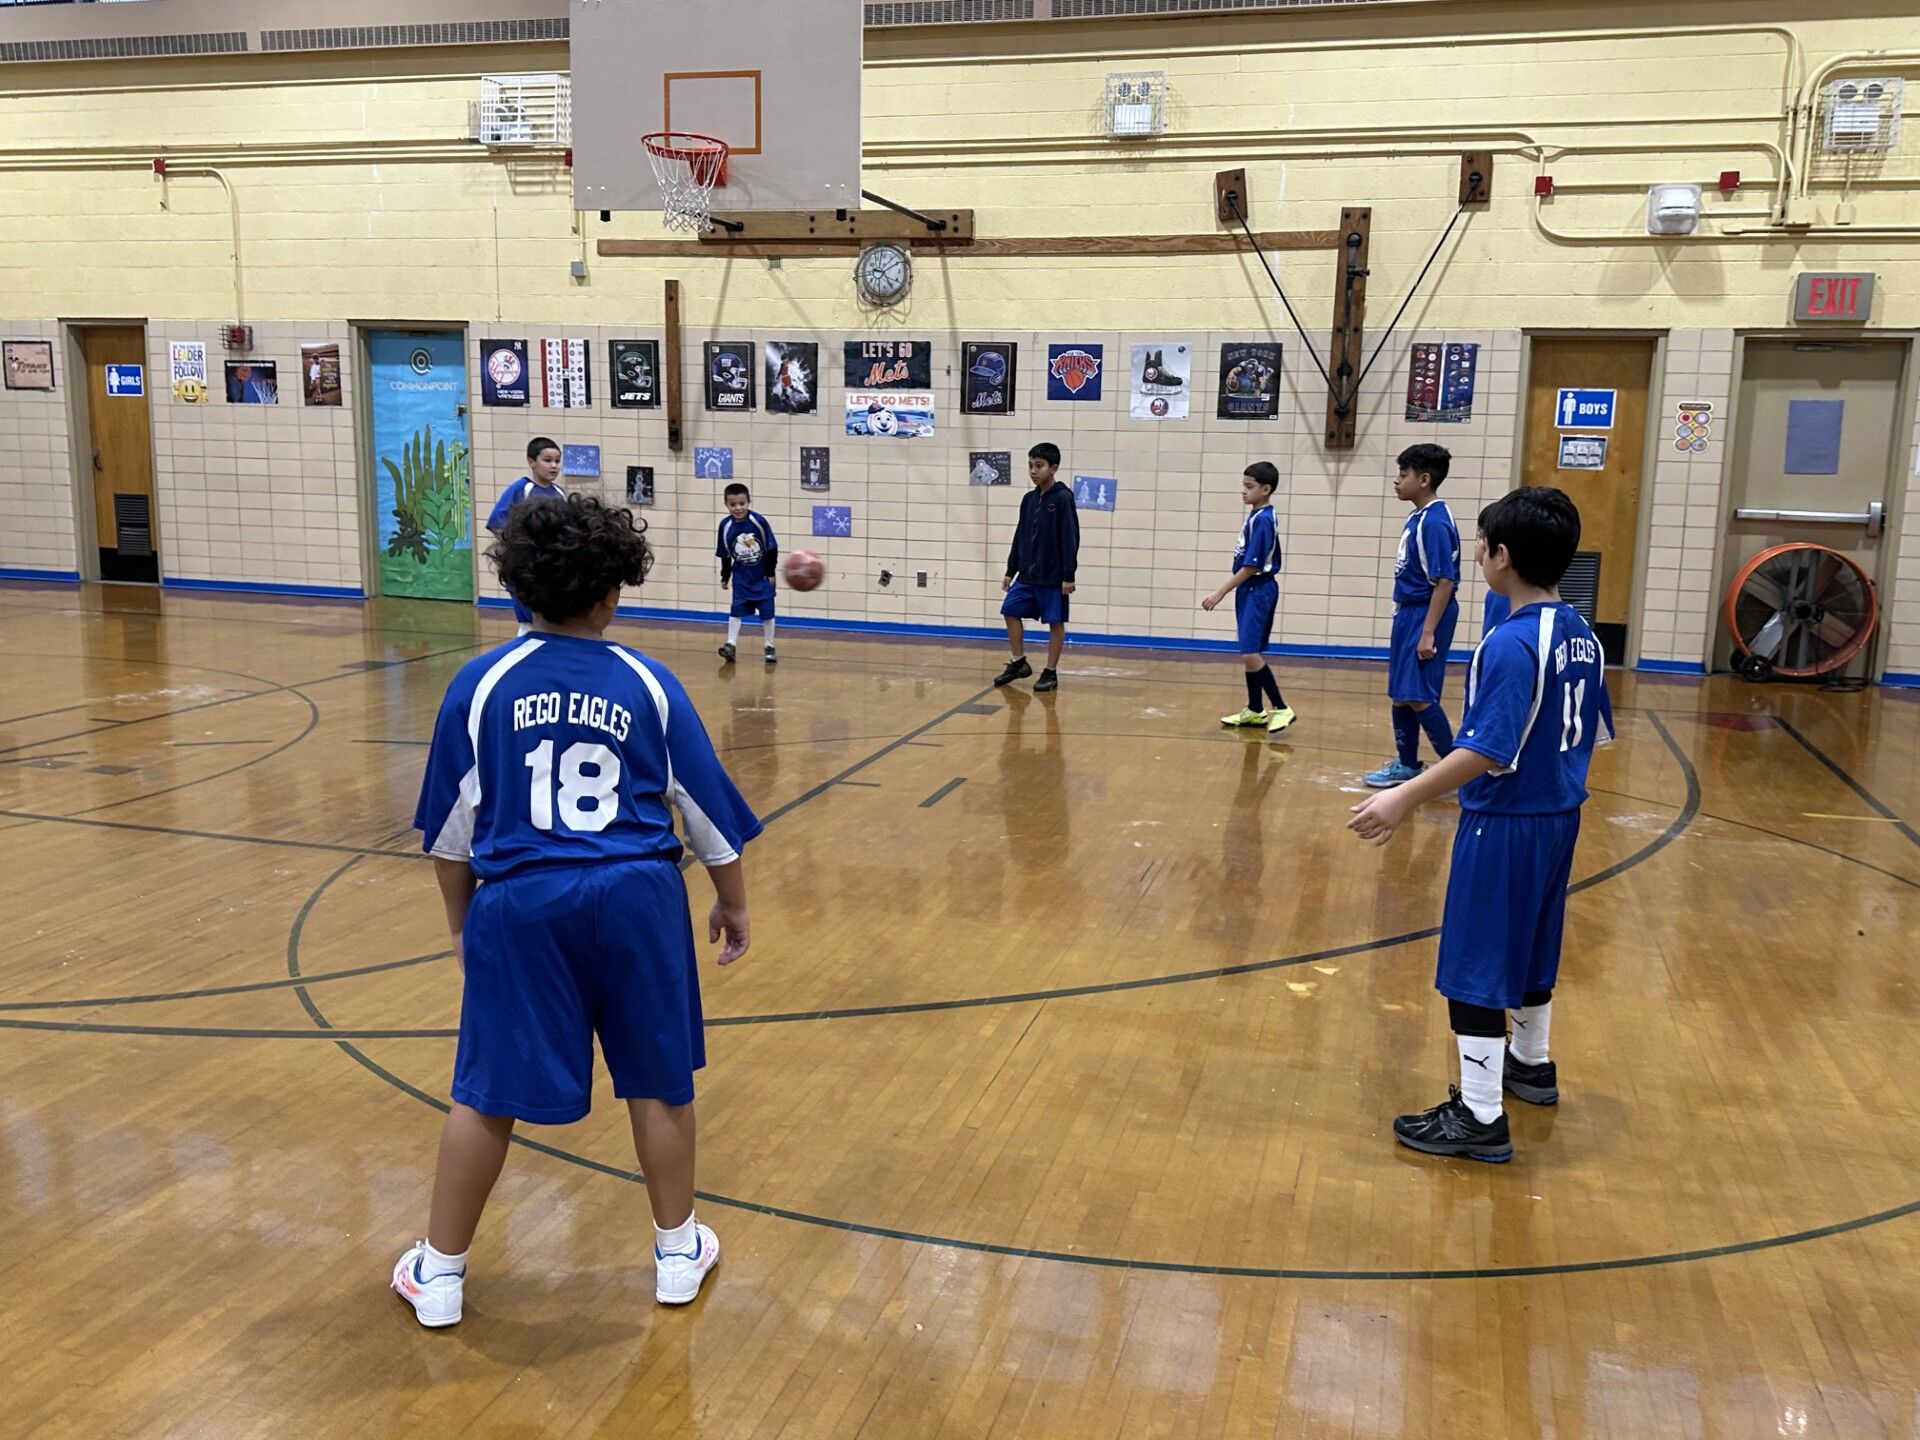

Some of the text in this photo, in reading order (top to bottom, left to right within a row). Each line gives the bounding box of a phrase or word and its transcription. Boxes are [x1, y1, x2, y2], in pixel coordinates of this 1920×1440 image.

[1808, 277, 1862, 315] EXIT
[173, 349, 203, 361] LEADER
[862, 342, 912, 358] LET'S GO
[1054, 356, 1096, 373] KNICKS
[174, 366, 204, 380] FOLLOW
[864, 360, 909, 386] Mets
[121, 376, 141, 386] GIRLS
[390, 381, 458, 391] COMMONPOINT
[620, 392, 651, 401] JETS
[718, 393, 745, 403] GIANTS
[850, 396, 930, 405] LET'S GO METS!
[972, 390, 1002, 408] Mets
[1579, 403, 1608, 415] BOYS
[513, 692, 631, 742] REGO EAGLES
[1559, 679, 1585, 752] 11
[525, 739, 621, 832] 18
